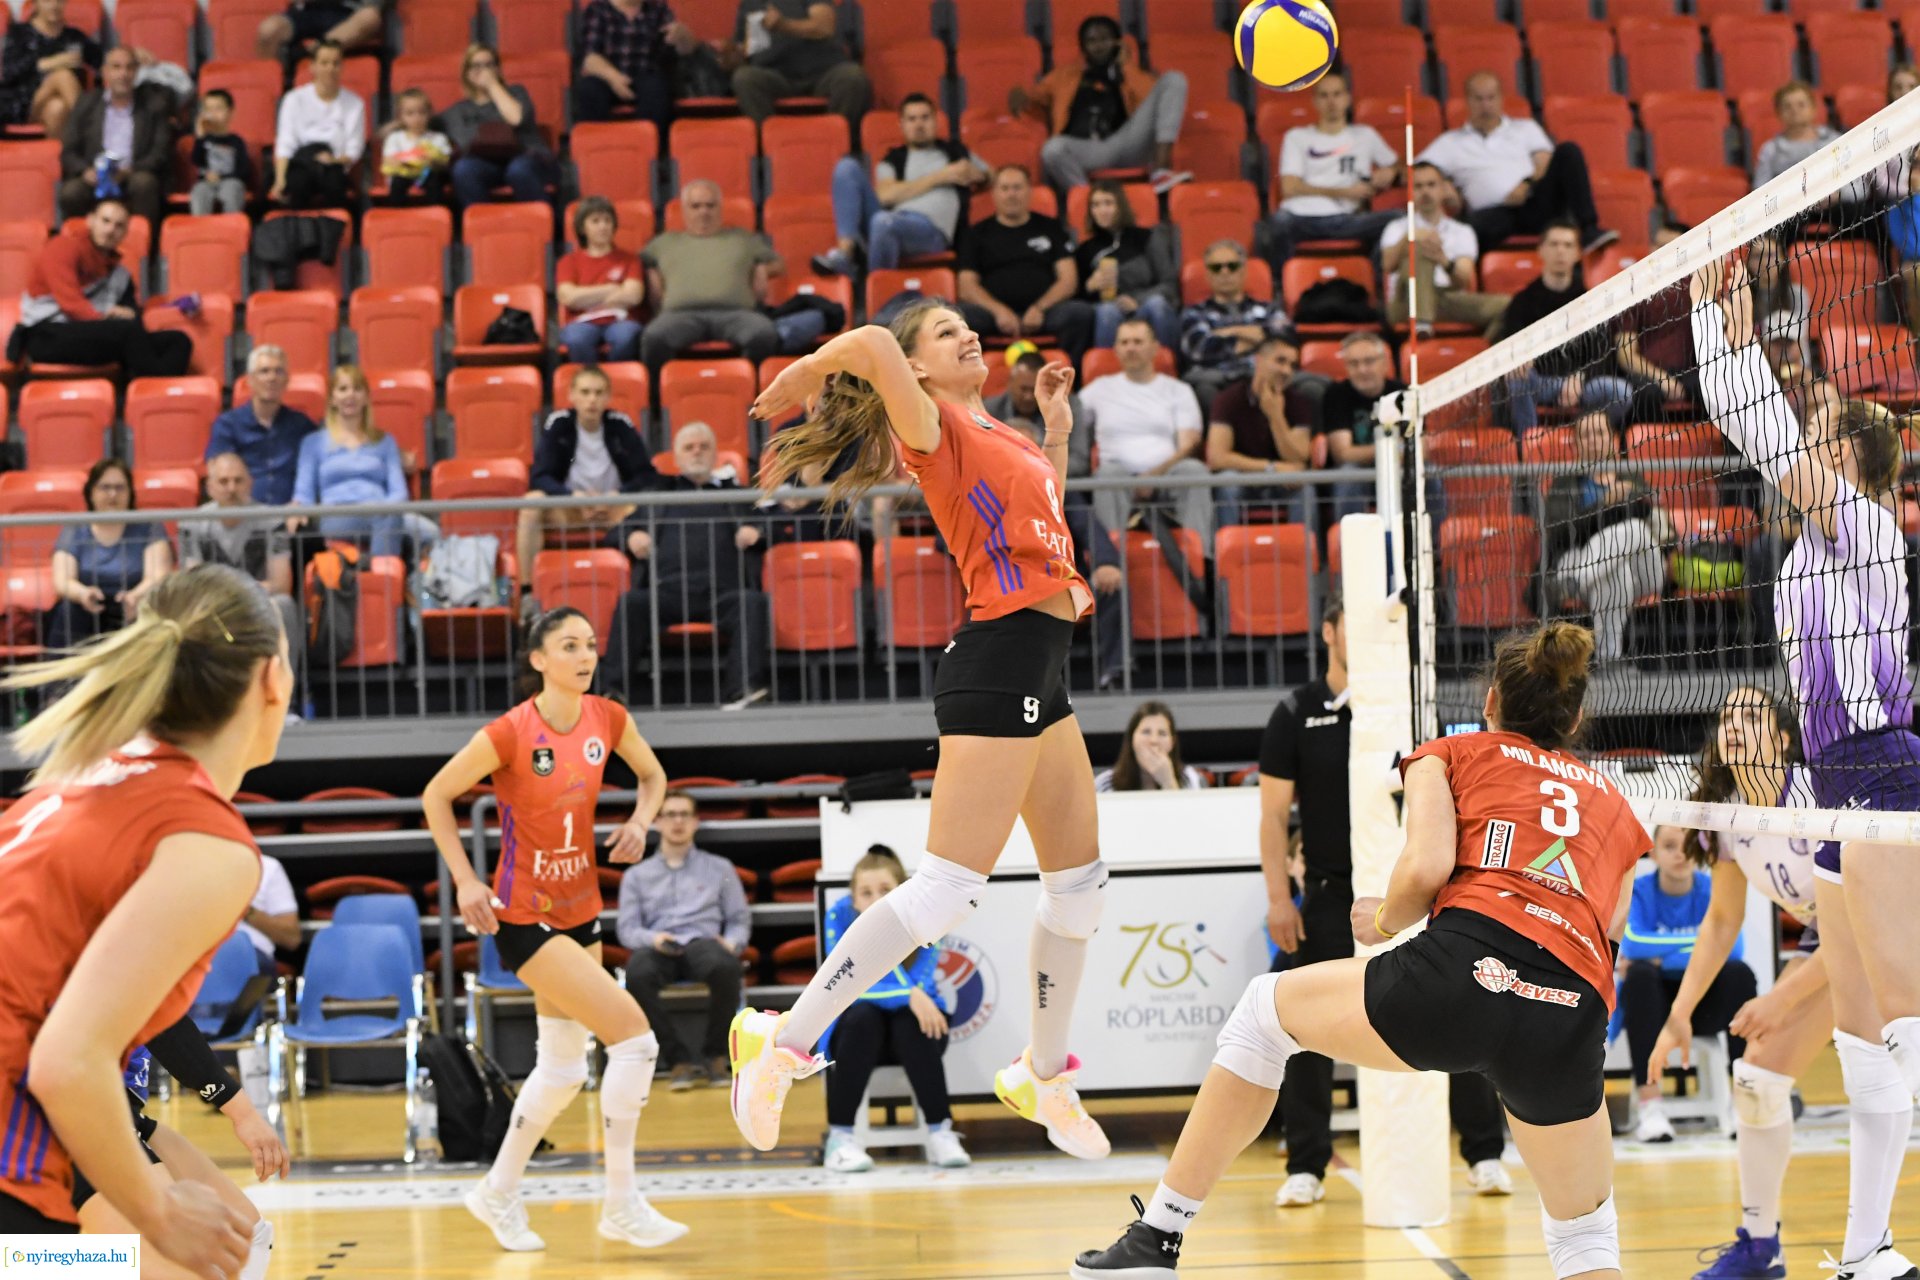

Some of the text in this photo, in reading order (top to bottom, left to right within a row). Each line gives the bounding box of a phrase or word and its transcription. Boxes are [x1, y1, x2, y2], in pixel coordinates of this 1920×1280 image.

[1023, 696, 1040, 724] 9
[1499, 744, 1609, 795] MILANOVA
[1539, 780, 1581, 837] 3
[553, 811, 579, 854] 1
[1764, 862, 1800, 898] 18
[823, 956, 855, 991] MIKASA
[1106, 1003, 1236, 1030] RÖPLABD
